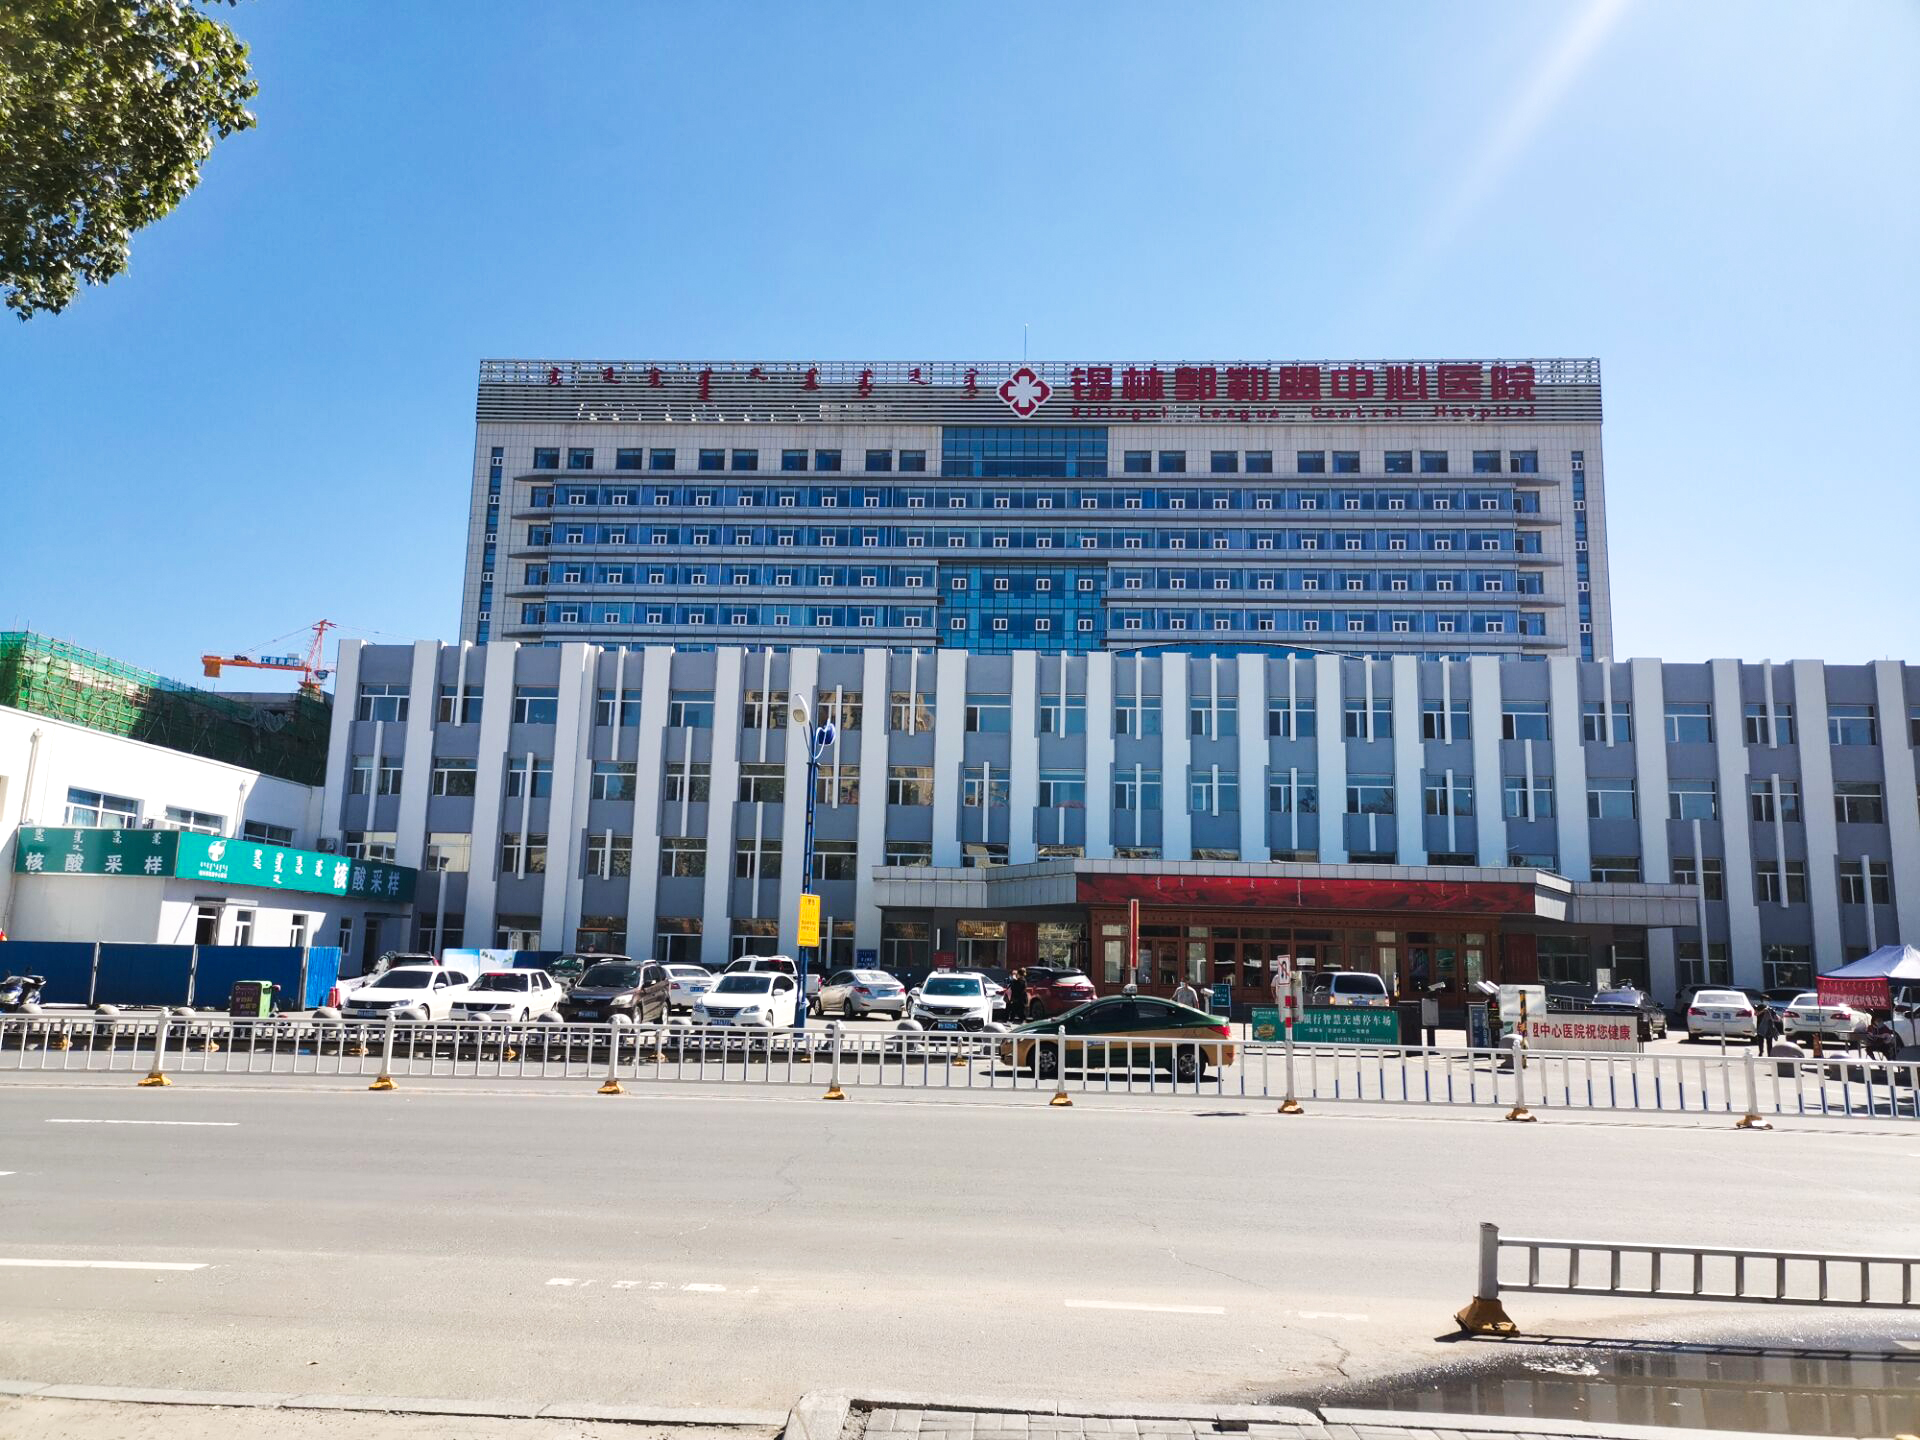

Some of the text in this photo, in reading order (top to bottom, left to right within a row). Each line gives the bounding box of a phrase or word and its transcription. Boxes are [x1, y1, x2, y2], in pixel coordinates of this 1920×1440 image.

[1071, 365, 1536, 401] 锡林郭勒盟中心医院
[1311, 405, 1403, 420] Central
[1437, 405, 1536, 421] Hospital
[25, 851, 164, 875] 核酸采样
[333, 860, 400, 895] 核酸采样
